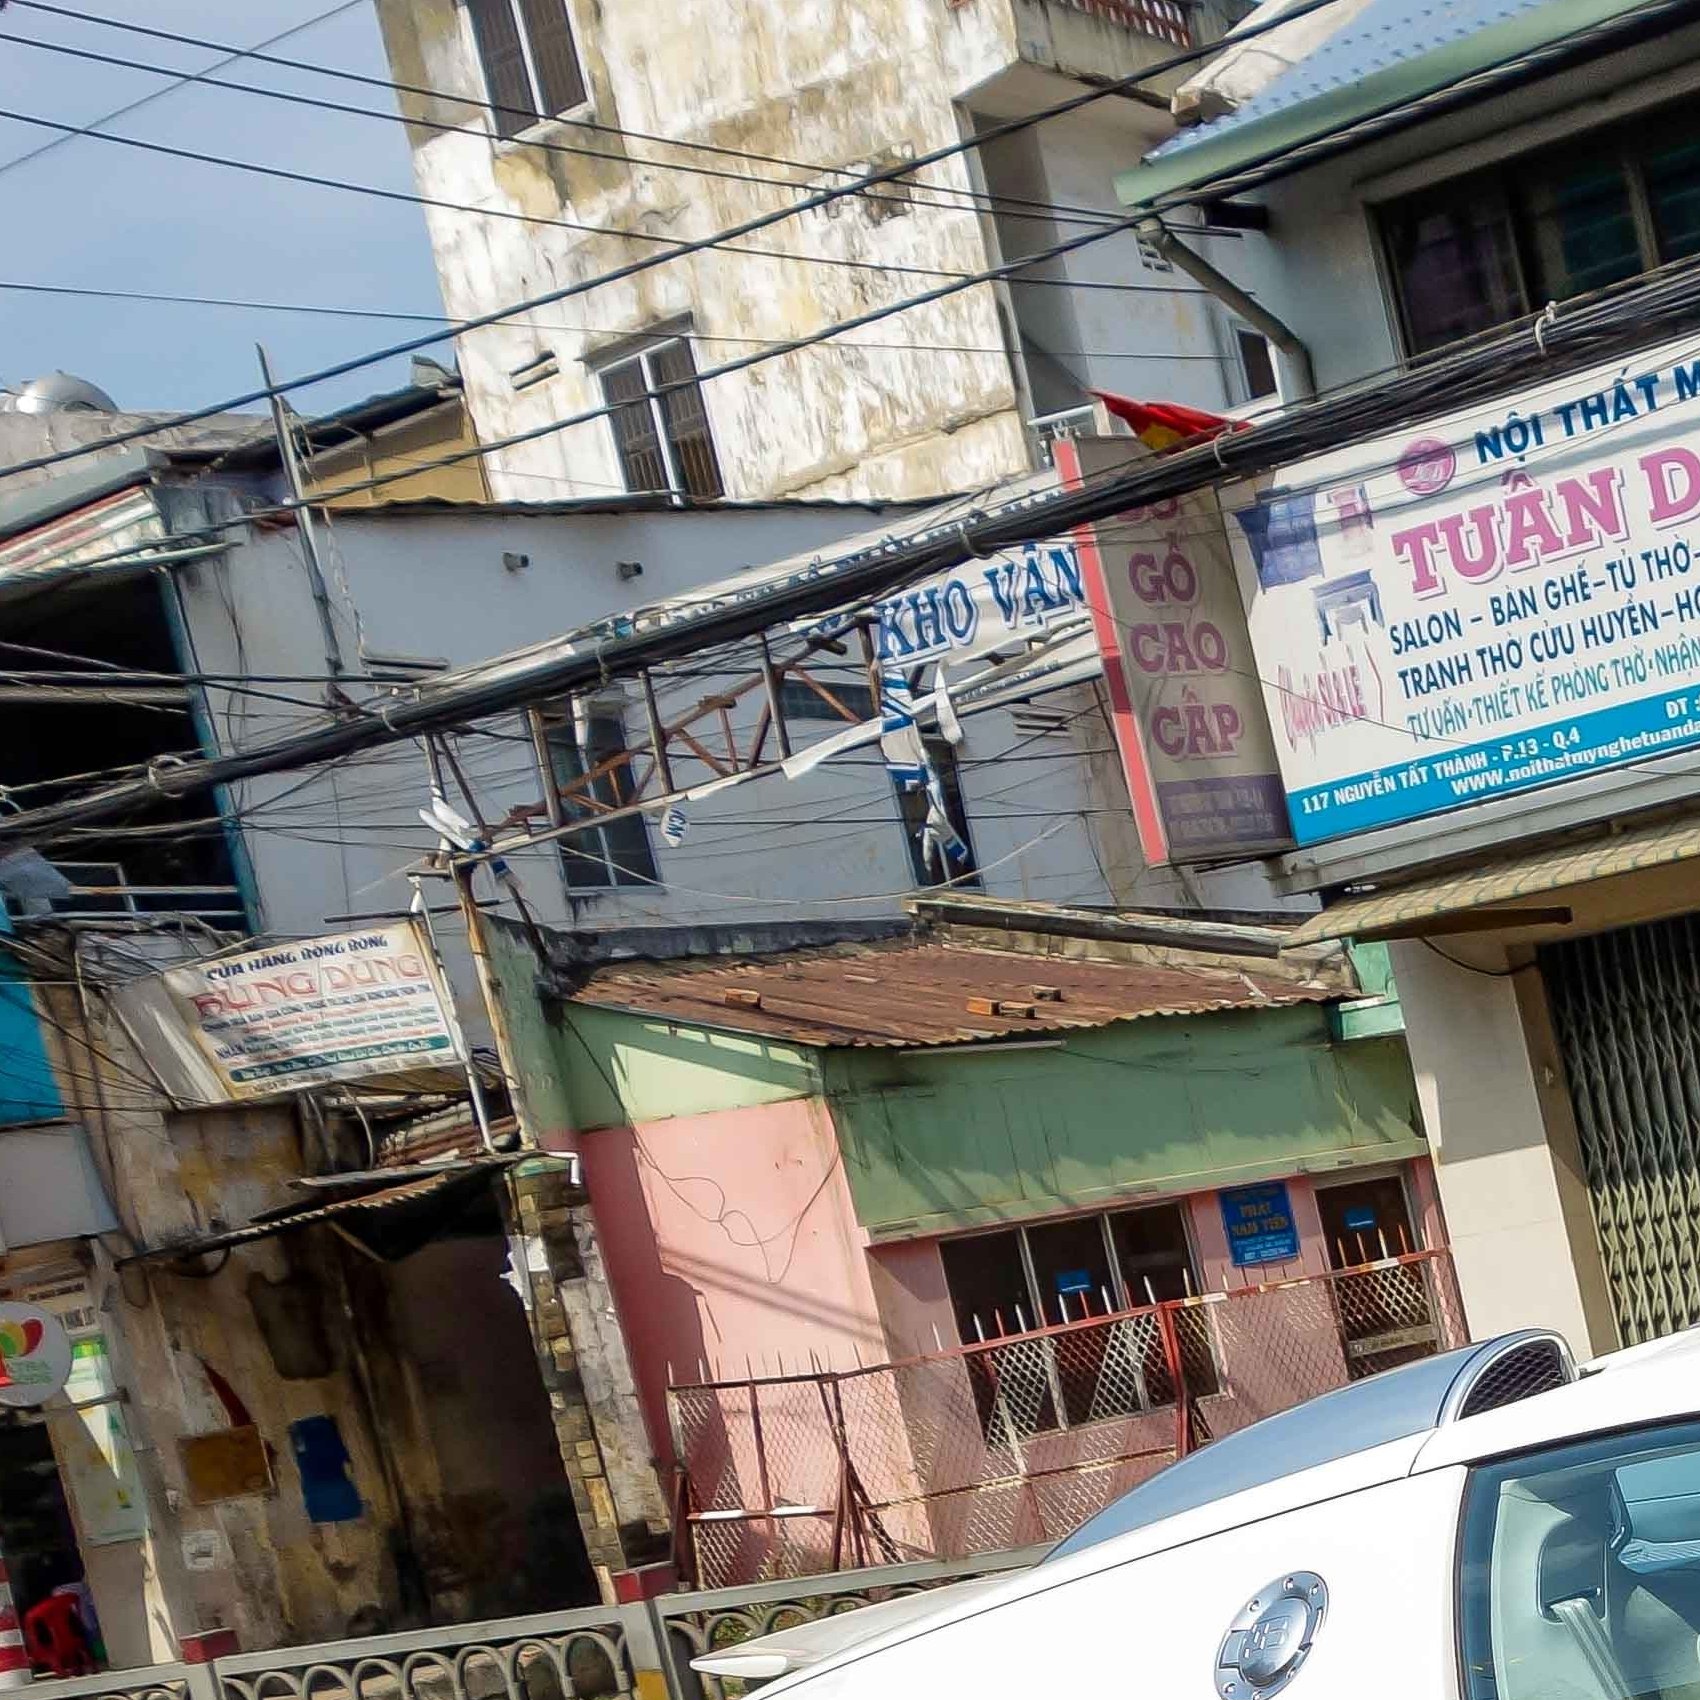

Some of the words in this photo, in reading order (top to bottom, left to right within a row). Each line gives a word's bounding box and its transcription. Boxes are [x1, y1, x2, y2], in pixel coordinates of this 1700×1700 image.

[1473, 412, 1545, 463] NỘI
[1555, 368, 1661, 438] THẤT
[874, 578, 977, 660] KHO
[1131, 620, 1227, 673] CAO
[1390, 607, 1463, 656] SALON
[1490, 585, 1539, 627] BÀN
[1398, 653, 1473, 700] TRANH
[1476, 631, 1523, 678] THỜ
[1529, 620, 1575, 663] CỬU
[1551, 661, 1610, 705] PHÒNG
[1302, 793, 1329, 814] 117
[1335, 769, 1397, 806] NGUYỄN
[1434, 750, 1489, 780] THÀNH
[1552, 726, 1581, 749] Q.4
